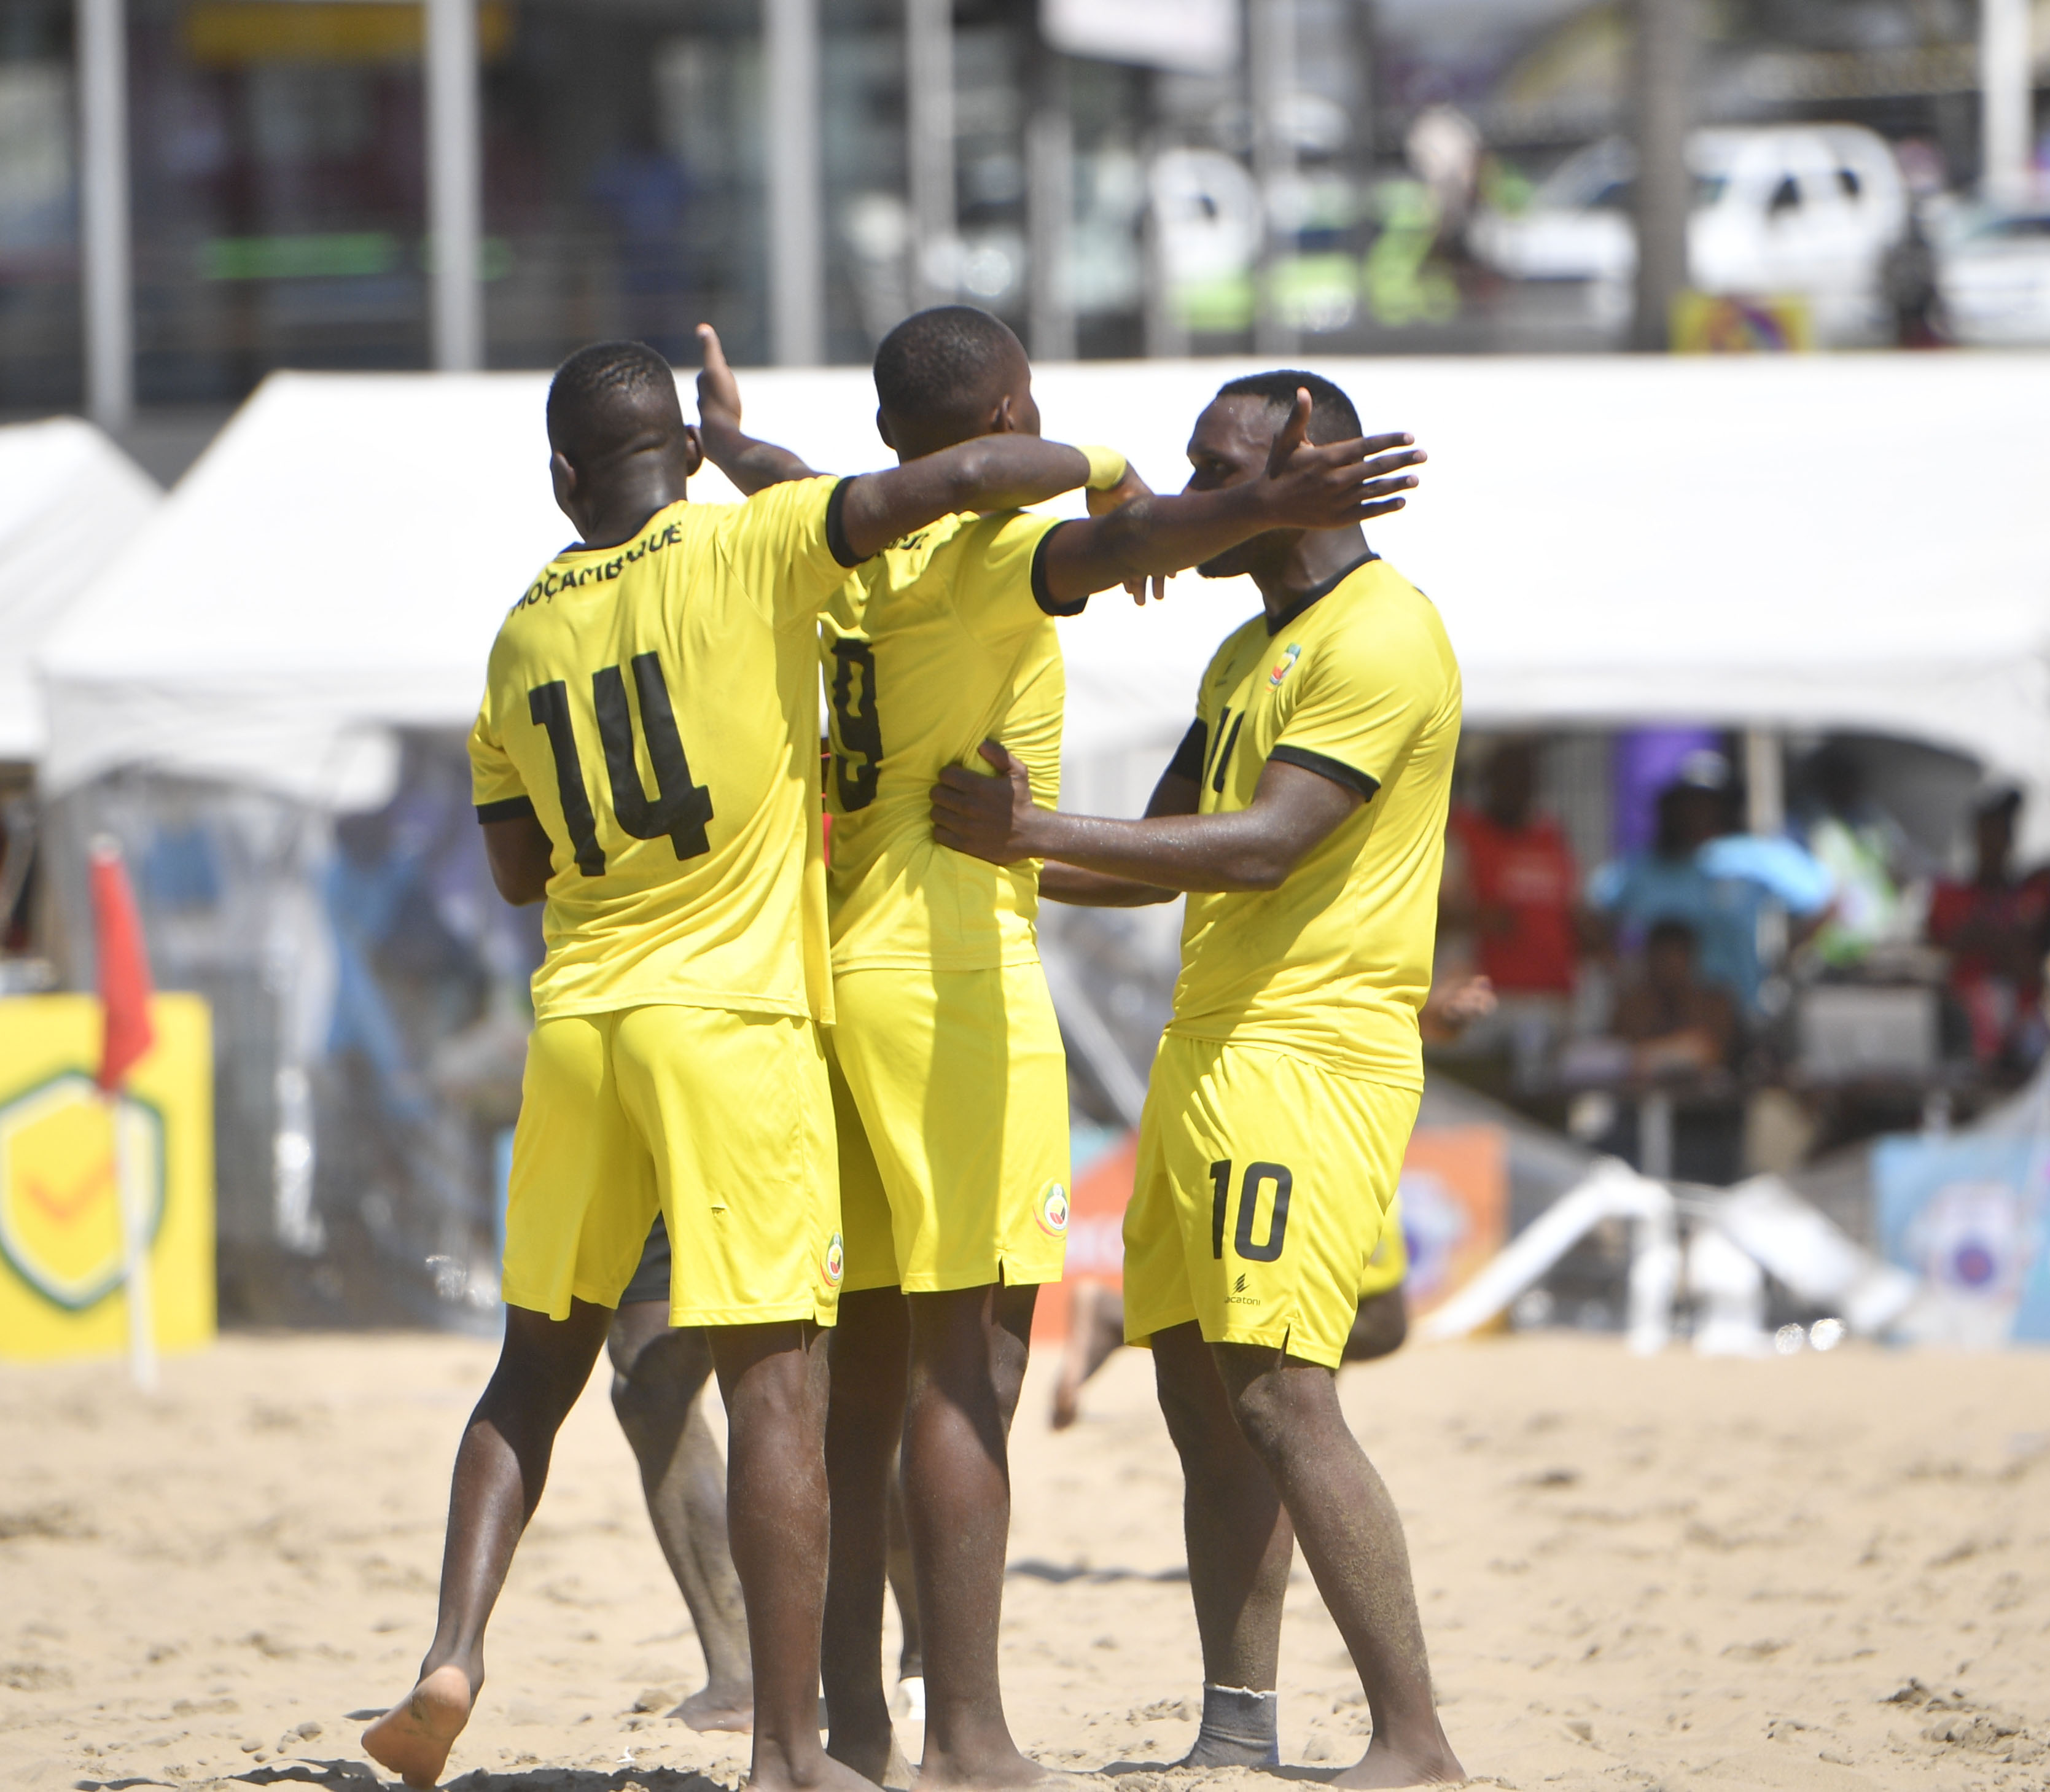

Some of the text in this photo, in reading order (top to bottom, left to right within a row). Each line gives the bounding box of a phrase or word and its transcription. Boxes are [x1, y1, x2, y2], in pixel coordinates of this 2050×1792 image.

[510, 521, 683, 617] MOÇAMBQUE
[528, 650, 714, 877] 14
[831, 638, 884, 812] 9
[1209, 1159, 1293, 1263] 10
